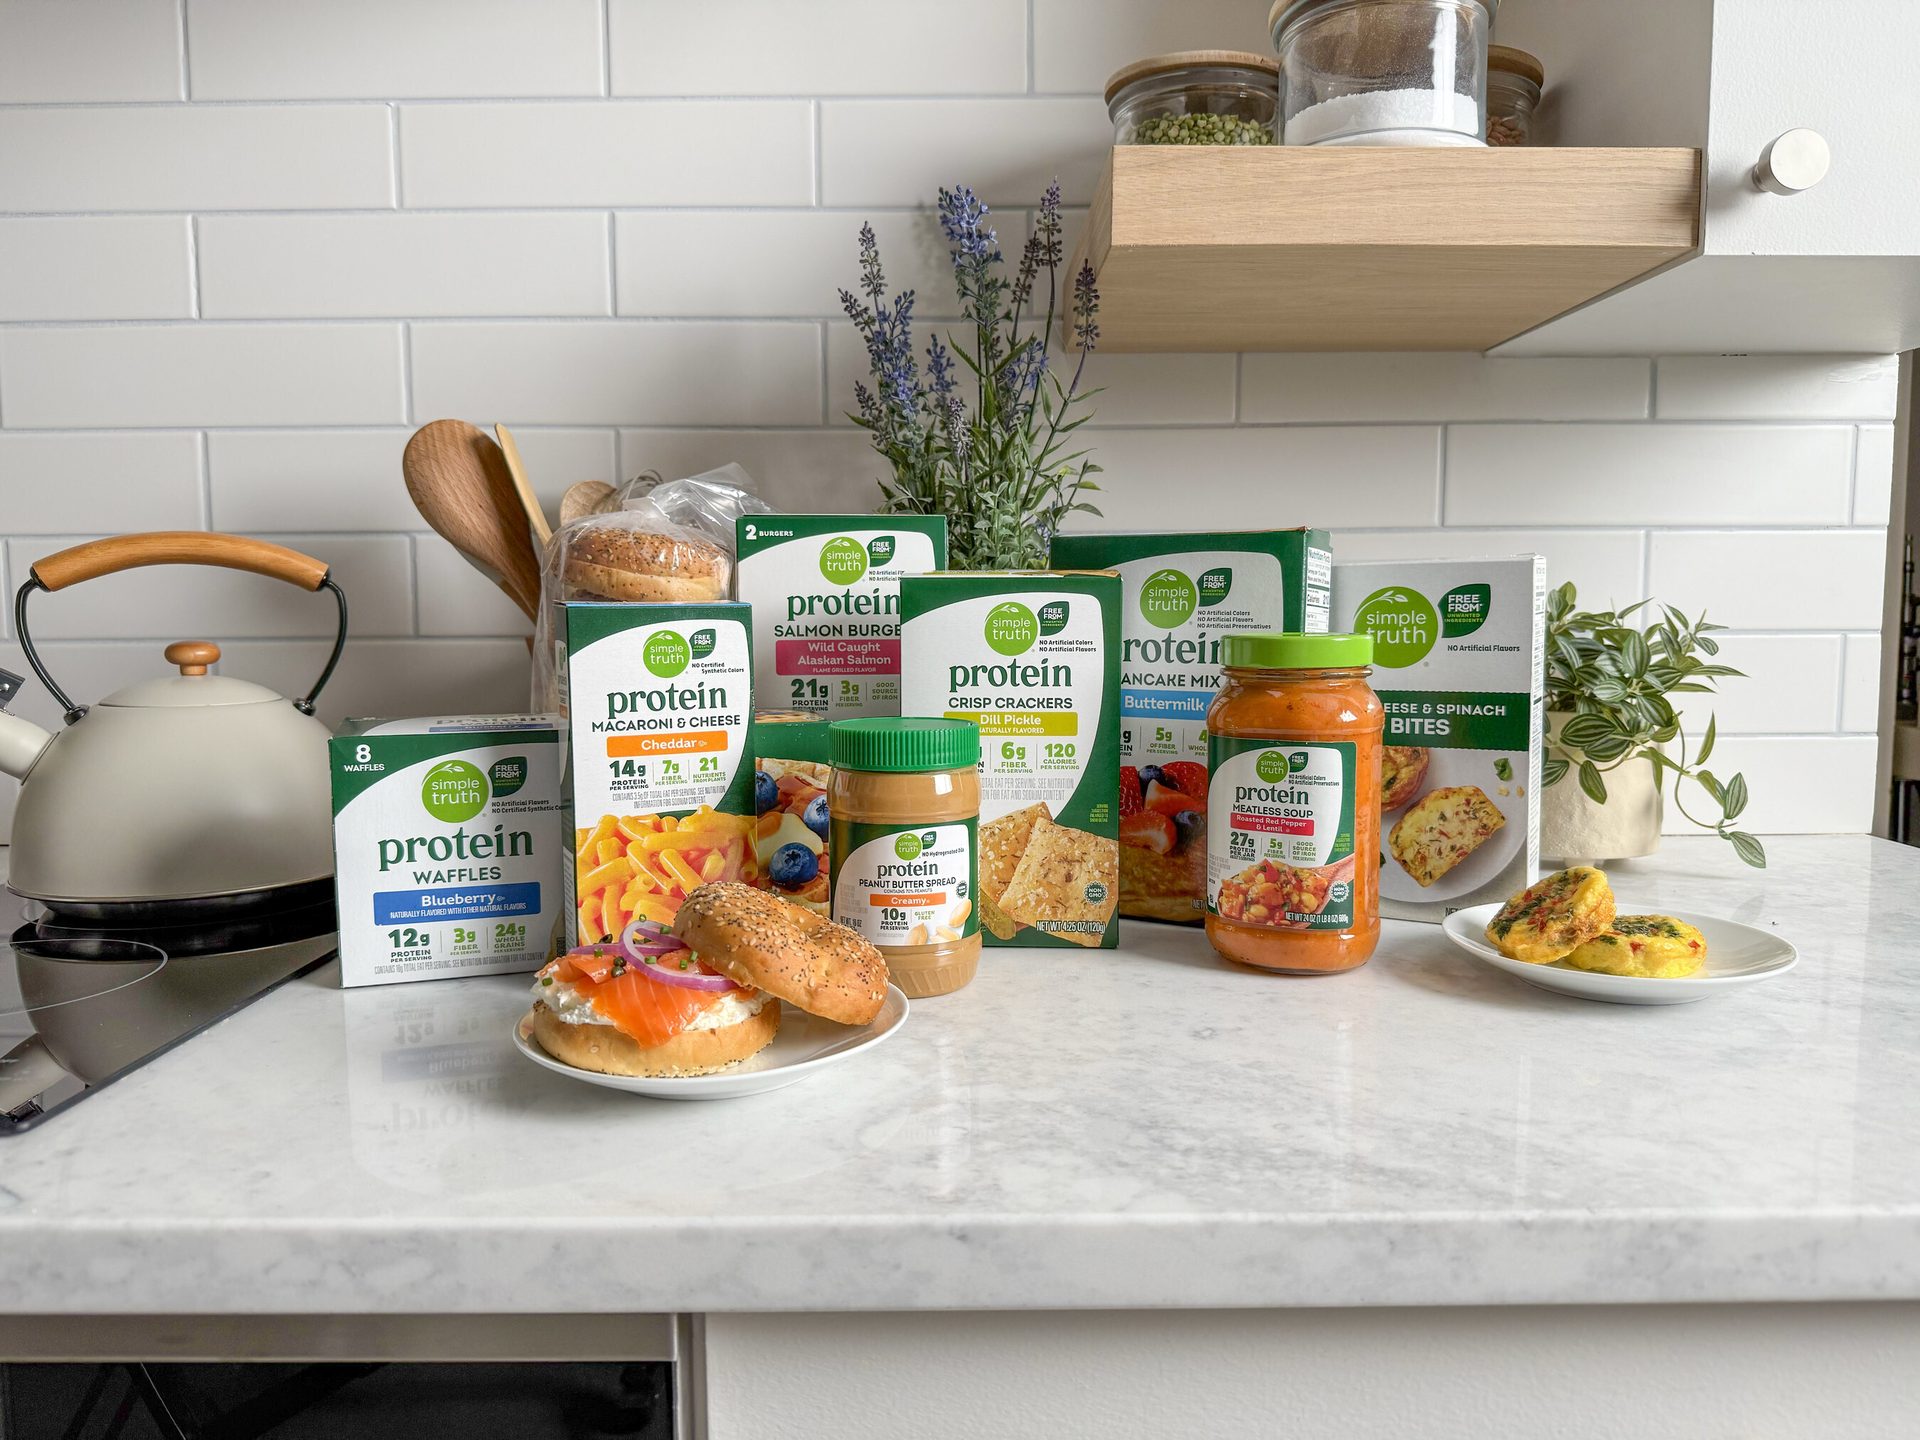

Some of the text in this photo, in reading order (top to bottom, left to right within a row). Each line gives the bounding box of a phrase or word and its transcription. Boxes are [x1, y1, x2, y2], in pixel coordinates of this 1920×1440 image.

[745, 524, 757, 540] 2
[826, 551, 861, 561] simple
[826, 560, 861, 571] truth
[1149, 587, 1189, 598] simple
[1448, 594, 1480, 603] FREE
[787, 588, 900, 621] protein
[1148, 599, 1188, 611] truth
[1448, 603, 1481, 612] FROM
[992, 618, 1031, 628] simple
[1366, 610, 1427, 627] simple
[774, 624, 900, 637] SALMON BURGE
[992, 629, 1031, 641] truth
[650, 644, 684, 656] simple
[808, 641, 881, 654] Wild Caught
[1122, 632, 1220, 665] rotei
[1459, 644, 1492, 652] Artificial
[650, 653, 684, 664] truth
[798, 655, 891, 665] Alaskan Salmon
[949, 658, 1072, 692] protein
[1121, 672, 1221, 688] ANCAKE MIX
[791, 678, 828, 698] 21g
[840, 680, 859, 695] 3g
[607, 681, 727, 719] protein
[949, 697, 1073, 709] CRISP CRACKERS
[1124, 696, 1204, 712] Buttermilk
[1384, 702, 1505, 717] EESE & SPINACH
[592, 715, 741, 732] MACARONI & CHEESE
[980, 714, 1042, 725] Dill Pickle
[1391, 717, 1450, 736] BITES
[1155, 727, 1173, 741] 5g
[641, 737, 697, 750] Cheddar
[1001, 741, 1026, 760] 6g
[1044, 743, 1076, 758] 120
[356, 744, 371, 762] 8
[344, 763, 385, 772] WAFFLES
[609, 759, 646, 778] 14g
[662, 760, 679, 774] 7g
[700, 757, 718, 771] 21
[1261, 760, 1284, 768] simple
[432, 777, 480, 791] simple
[432, 789, 481, 805] truth
[1235, 785, 1309, 805] protein
[527, 805, 554, 814] Synthetic
[1232, 804, 1313, 818] MEATLESS SOUP
[1236, 815, 1307, 828] Roasted Red Pepper
[1230, 832, 1255, 848] 27g
[1269, 838, 1283, 850] 5g
[378, 824, 533, 872] protein
[1229, 845, 1255, 854] PROTEIN
[413, 866, 502, 885] WAFFLES
[877, 861, 938, 879] protein
[859, 877, 956, 889] PEANUT BUTTER SPREAD
[421, 893, 496, 907] Blueberry
[891, 897, 926, 905] Creamy
[390, 902, 526, 919] NATURALLY FLAVORED WITH OTHER NATURAL FLAVORS
[881, 908, 906, 921] 10g
[495, 923, 526, 937] 24g
[1036, 921, 1049, 931] NET
[1050, 921, 1062, 932] WT
[1077, 921, 1086, 932] OZ
[388, 928, 430, 948] 12g
[453, 928, 476, 943] 3g
[494, 941, 525, 949] GRAINS
[391, 949, 431, 958] PROTEIN
